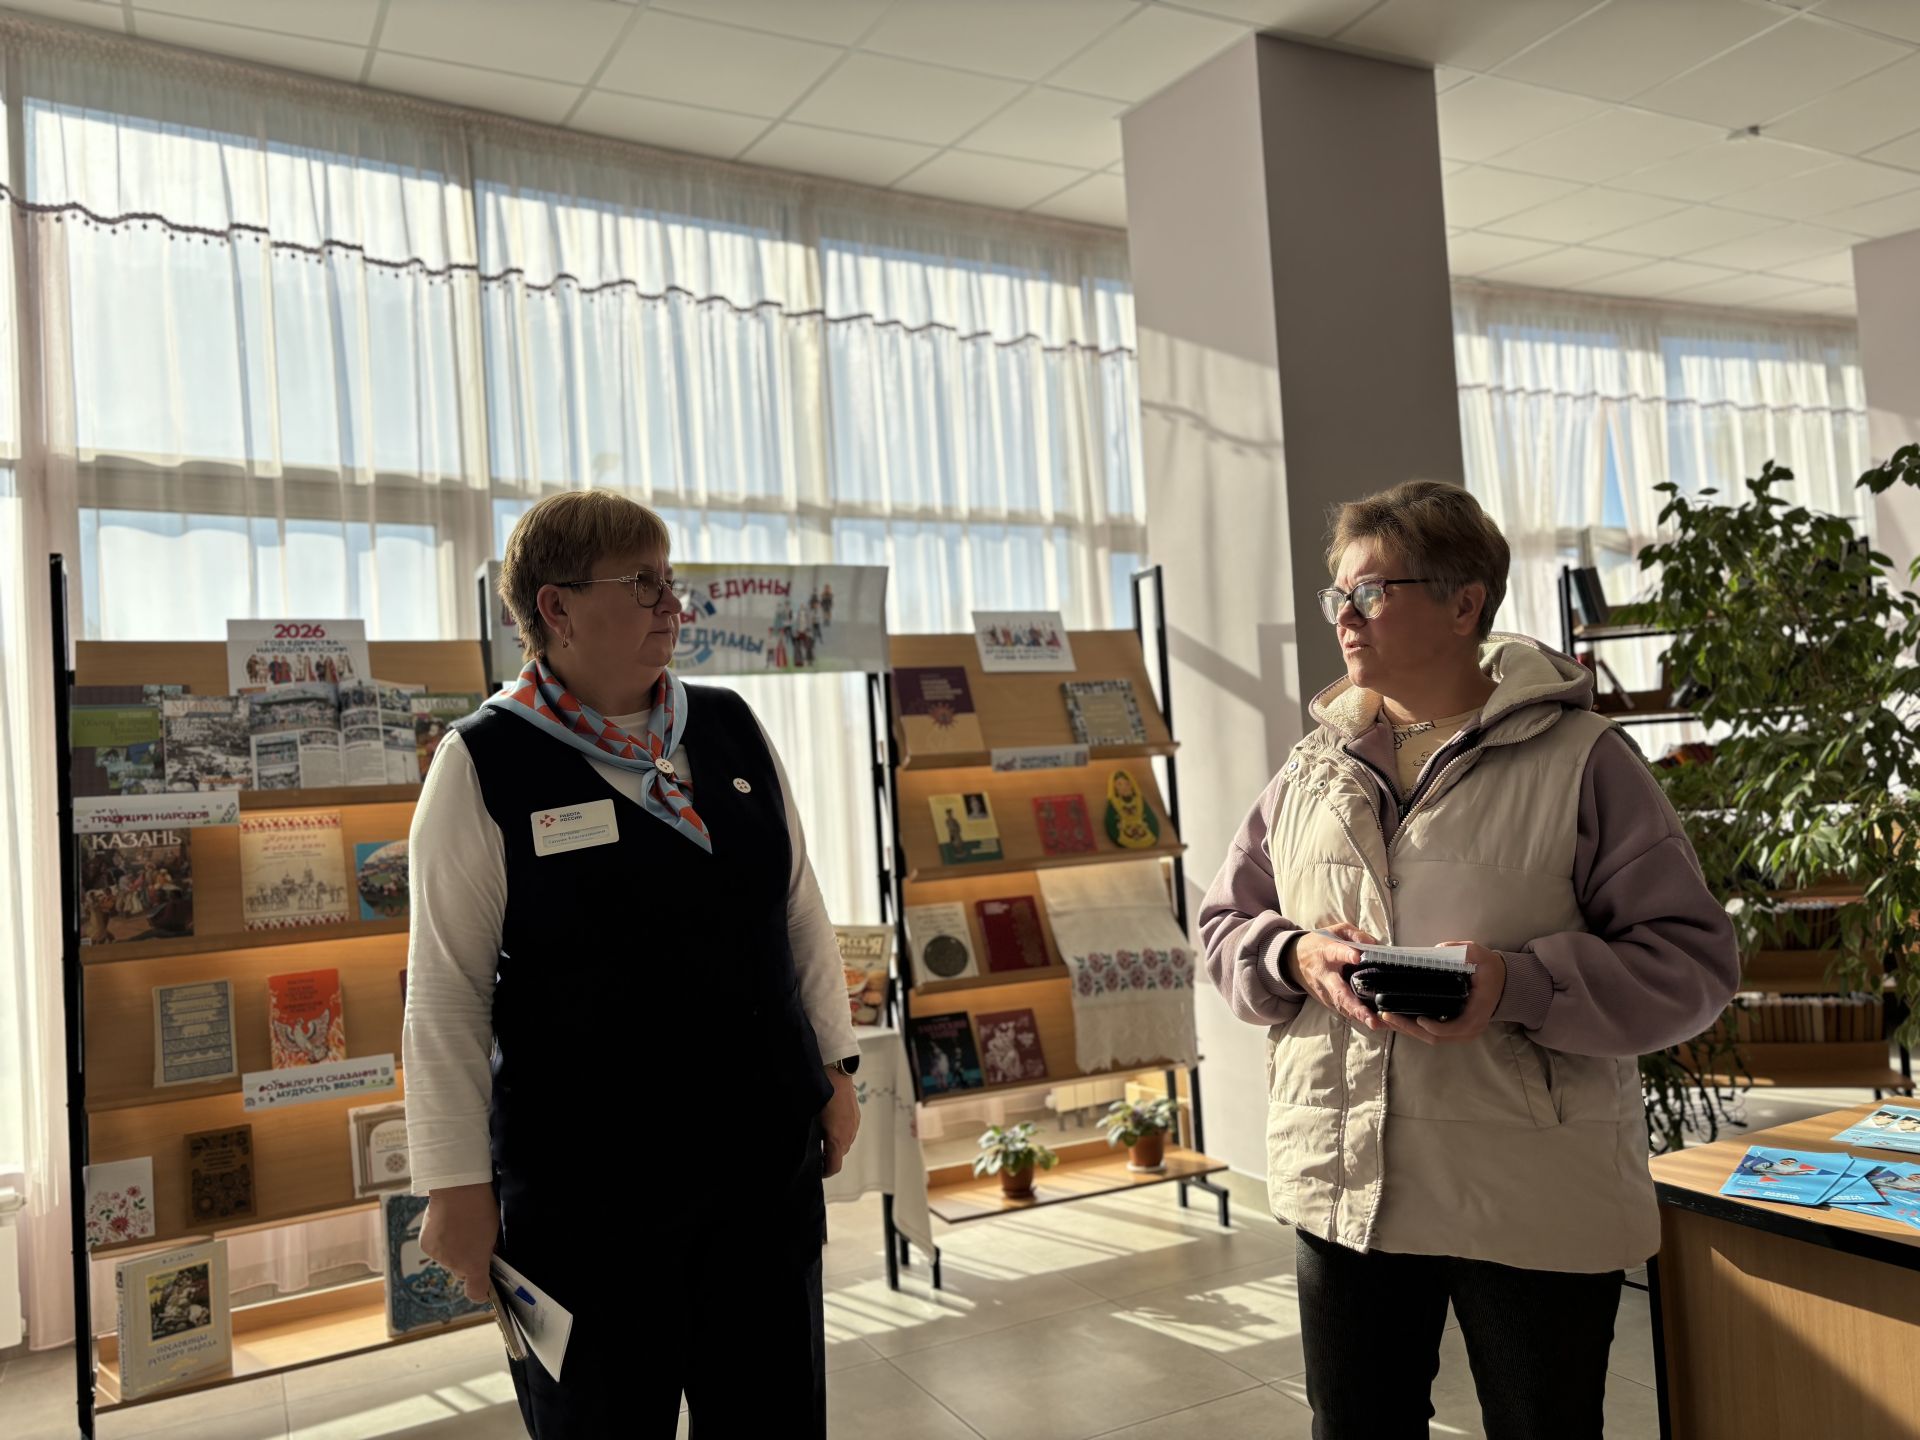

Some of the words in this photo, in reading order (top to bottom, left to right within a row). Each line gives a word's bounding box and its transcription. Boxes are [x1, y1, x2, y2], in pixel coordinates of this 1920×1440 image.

[708, 578, 791, 600] ЕДИНЫ
[274, 624, 325, 639] 2026
[679, 627, 764, 654] ЕДИМЫ
[155, 810, 210, 822] НАРОДОВ
[91, 830, 182, 850] КАЗАНЬ
[325, 1068, 379, 1084] СКАЗАНИЯ
[276, 1084, 331, 1099] МУДРОСТЬ
[334, 1078, 366, 1091] ВЕКОВ
